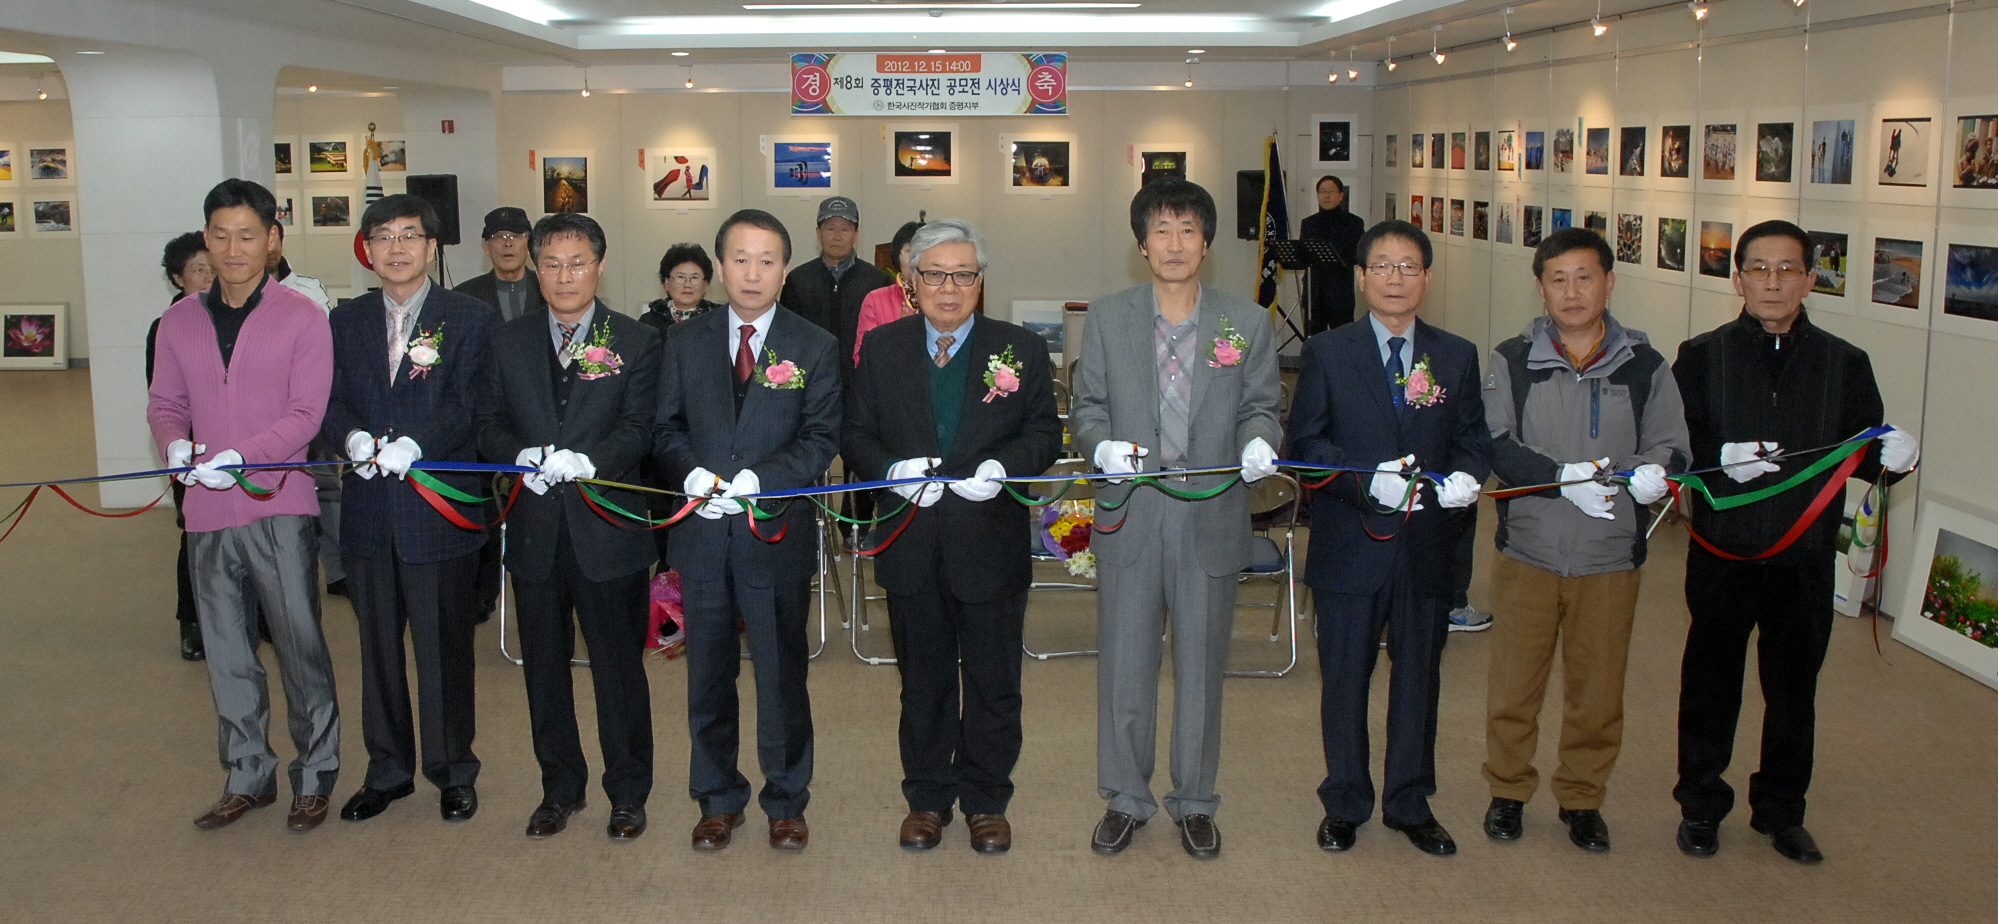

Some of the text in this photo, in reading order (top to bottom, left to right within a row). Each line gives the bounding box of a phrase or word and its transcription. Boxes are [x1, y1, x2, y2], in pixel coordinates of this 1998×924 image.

[884, 61, 971, 72] 2012. 12. 15 14:00
[802, 72, 820, 96] 경
[833, 75, 1021, 96] 제8회 증평전국사진 공모전 시상식
[1034, 71, 1057, 96] 축
[887, 101, 979, 111] 한국사진작가협회 증평지부
